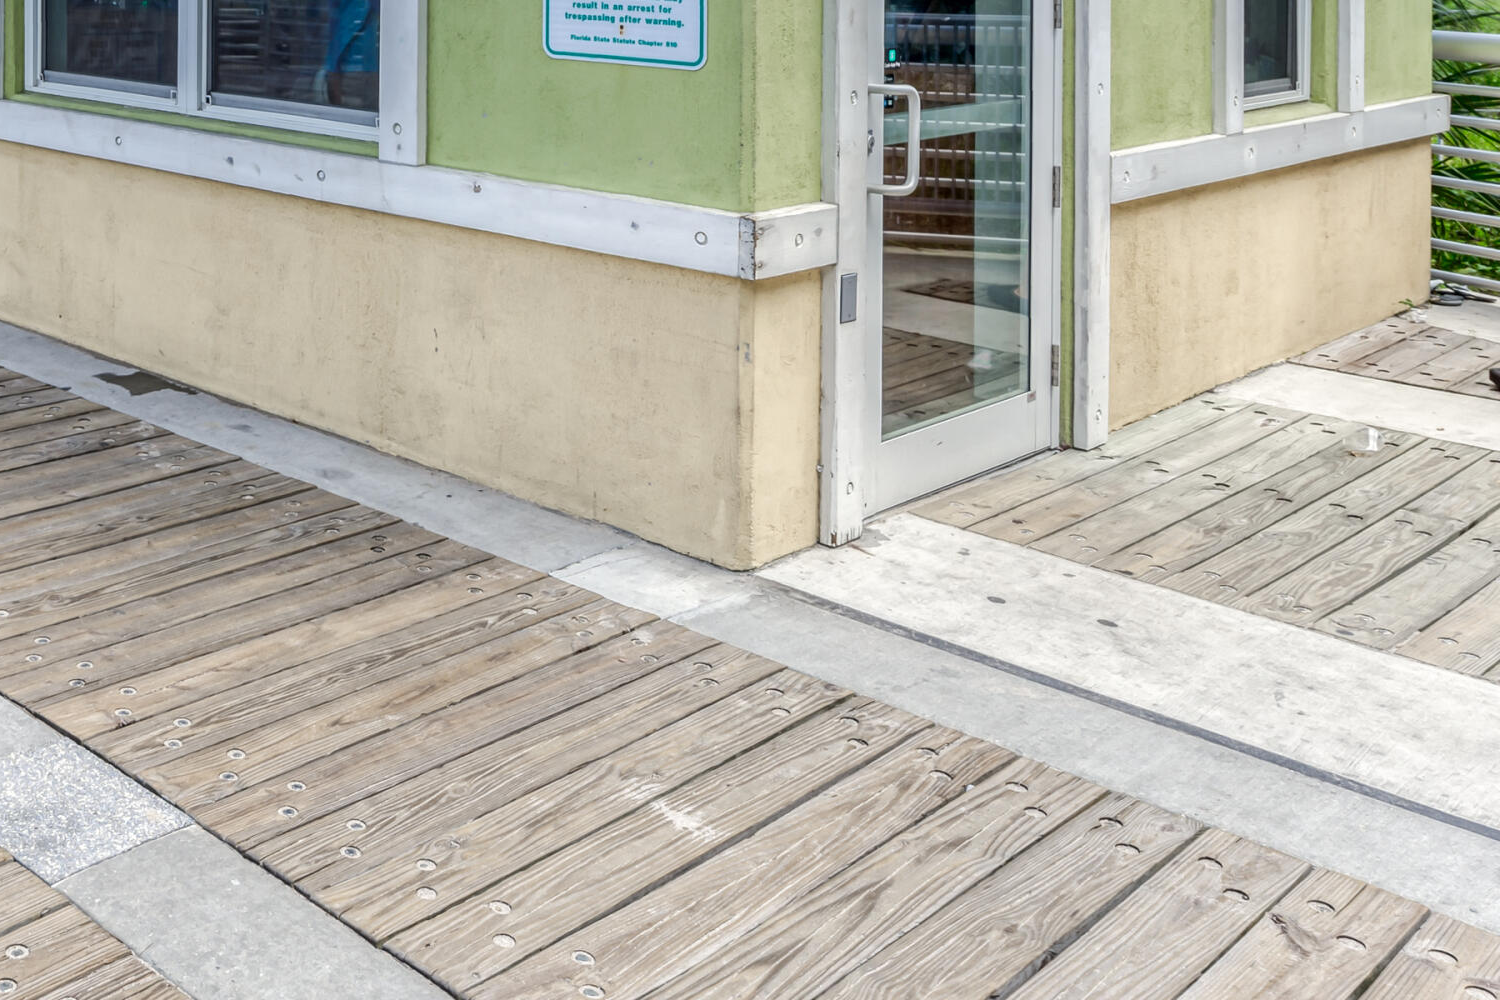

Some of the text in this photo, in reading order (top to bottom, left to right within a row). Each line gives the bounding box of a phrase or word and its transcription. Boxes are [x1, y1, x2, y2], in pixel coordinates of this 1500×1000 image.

[572, 1, 598, 9] result
[601, 2, 610, 10] in
[627, 4, 655, 12] arrest
[660, 5, 672, 14] for
[564, 12, 684, 28] trespassing after warning.
[570, 34, 591, 42] Florida
[638, 39, 663, 47] Chapter
